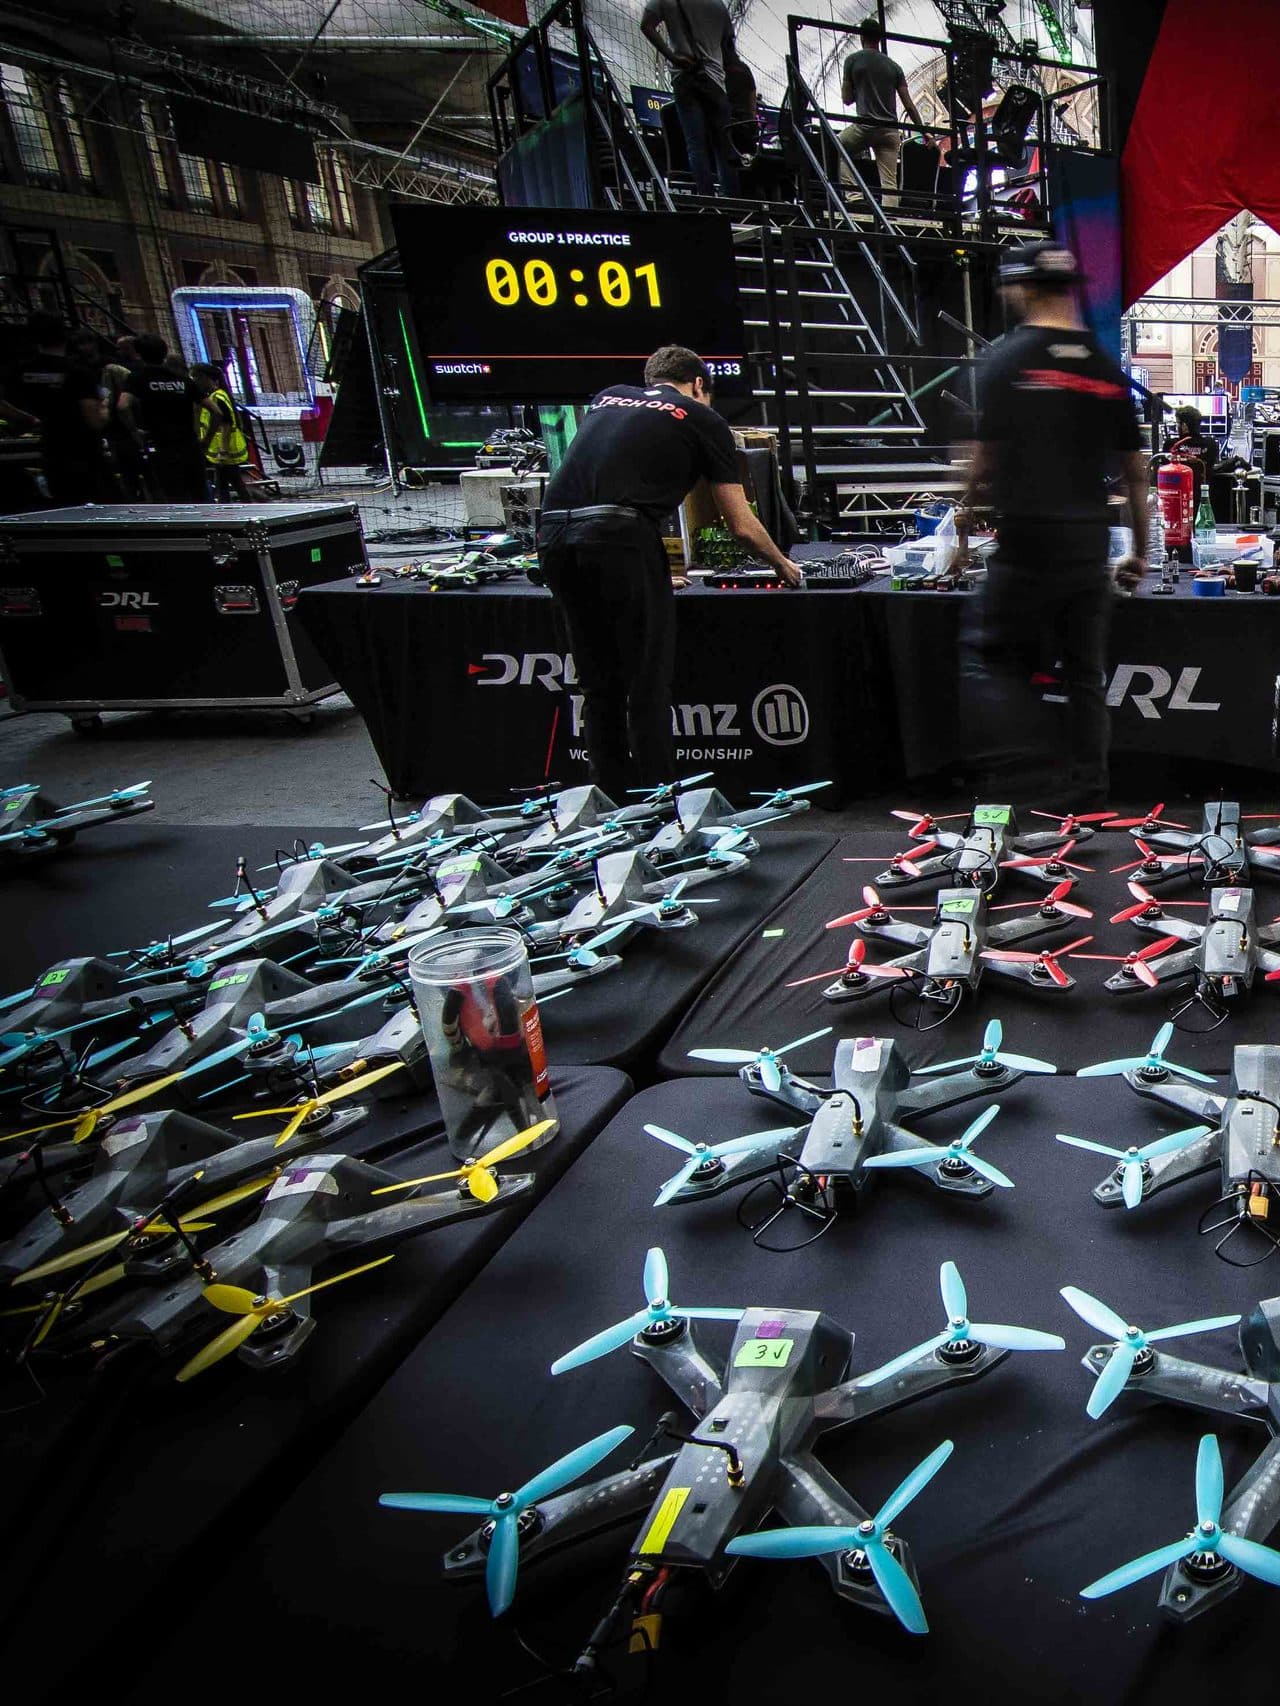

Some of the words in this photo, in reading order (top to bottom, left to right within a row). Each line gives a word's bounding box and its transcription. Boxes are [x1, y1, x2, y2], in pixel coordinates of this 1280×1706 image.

[508, 232, 555, 244] GROUP
[557, 233, 566, 244] 1
[567, 233, 631, 246] PRACTICE
[485, 258, 661, 308] 00:01
[435, 363, 482, 374] swatch
[150, 381, 185, 391] CREW
[599, 396, 647, 409] TECH
[646, 400, 688, 420] OPS
[100, 591, 160, 609] DRL
[477, 653, 579, 691] DRL
[676, 748, 753, 760] PIONSHIP
